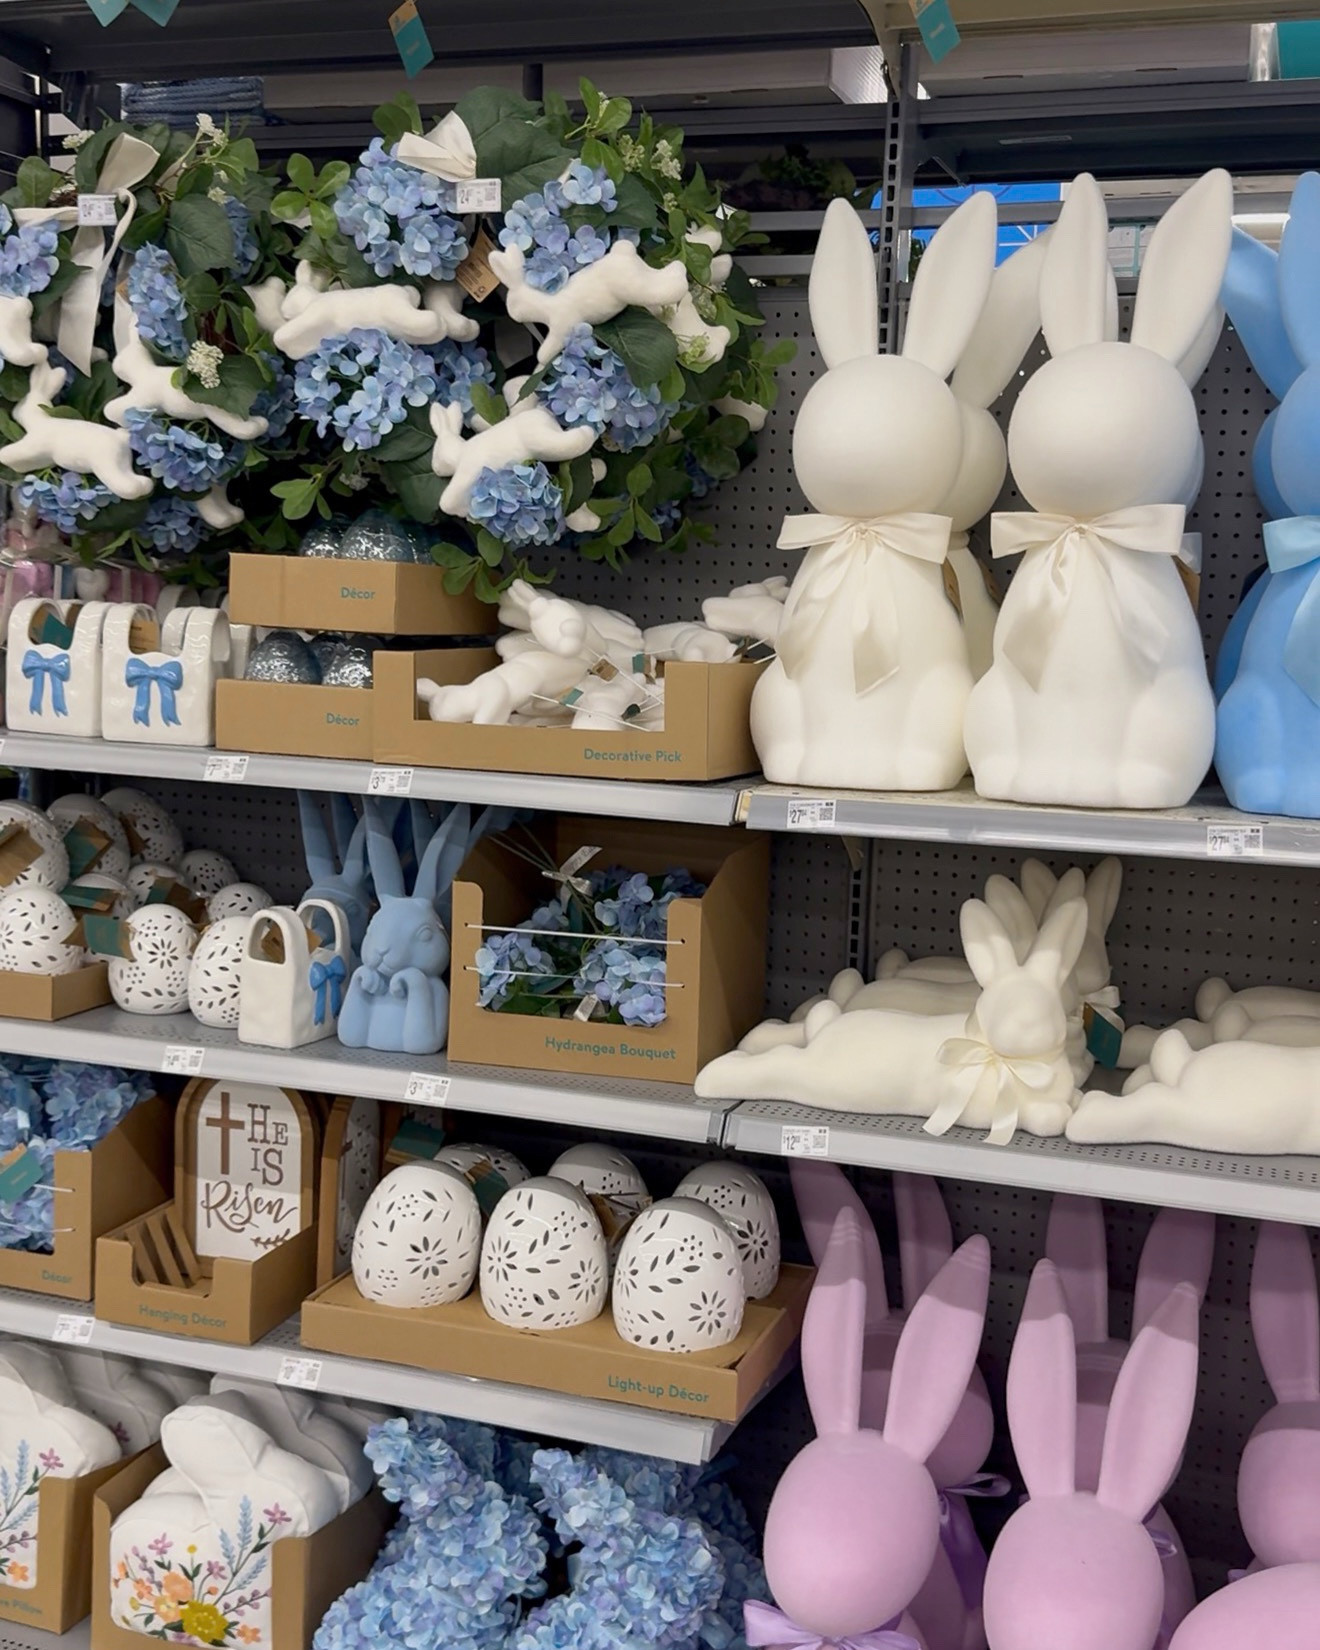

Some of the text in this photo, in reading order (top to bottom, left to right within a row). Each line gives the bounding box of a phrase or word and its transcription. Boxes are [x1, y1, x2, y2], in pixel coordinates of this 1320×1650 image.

[341, 586, 376, 600] Décor
[326, 712, 360, 726] Décor
[584, 748, 682, 763] Decorative Pick
[545, 1036, 676, 1060] Hydrangea Bouquet
[247, 1103, 288, 1146] HE
[251, 1147, 284, 1186] IS
[200, 1180, 298, 1233] Risen
[139, 1303, 226, 1328] Hanging Décor
[608, 1374, 709, 1402] Light-up Décor
